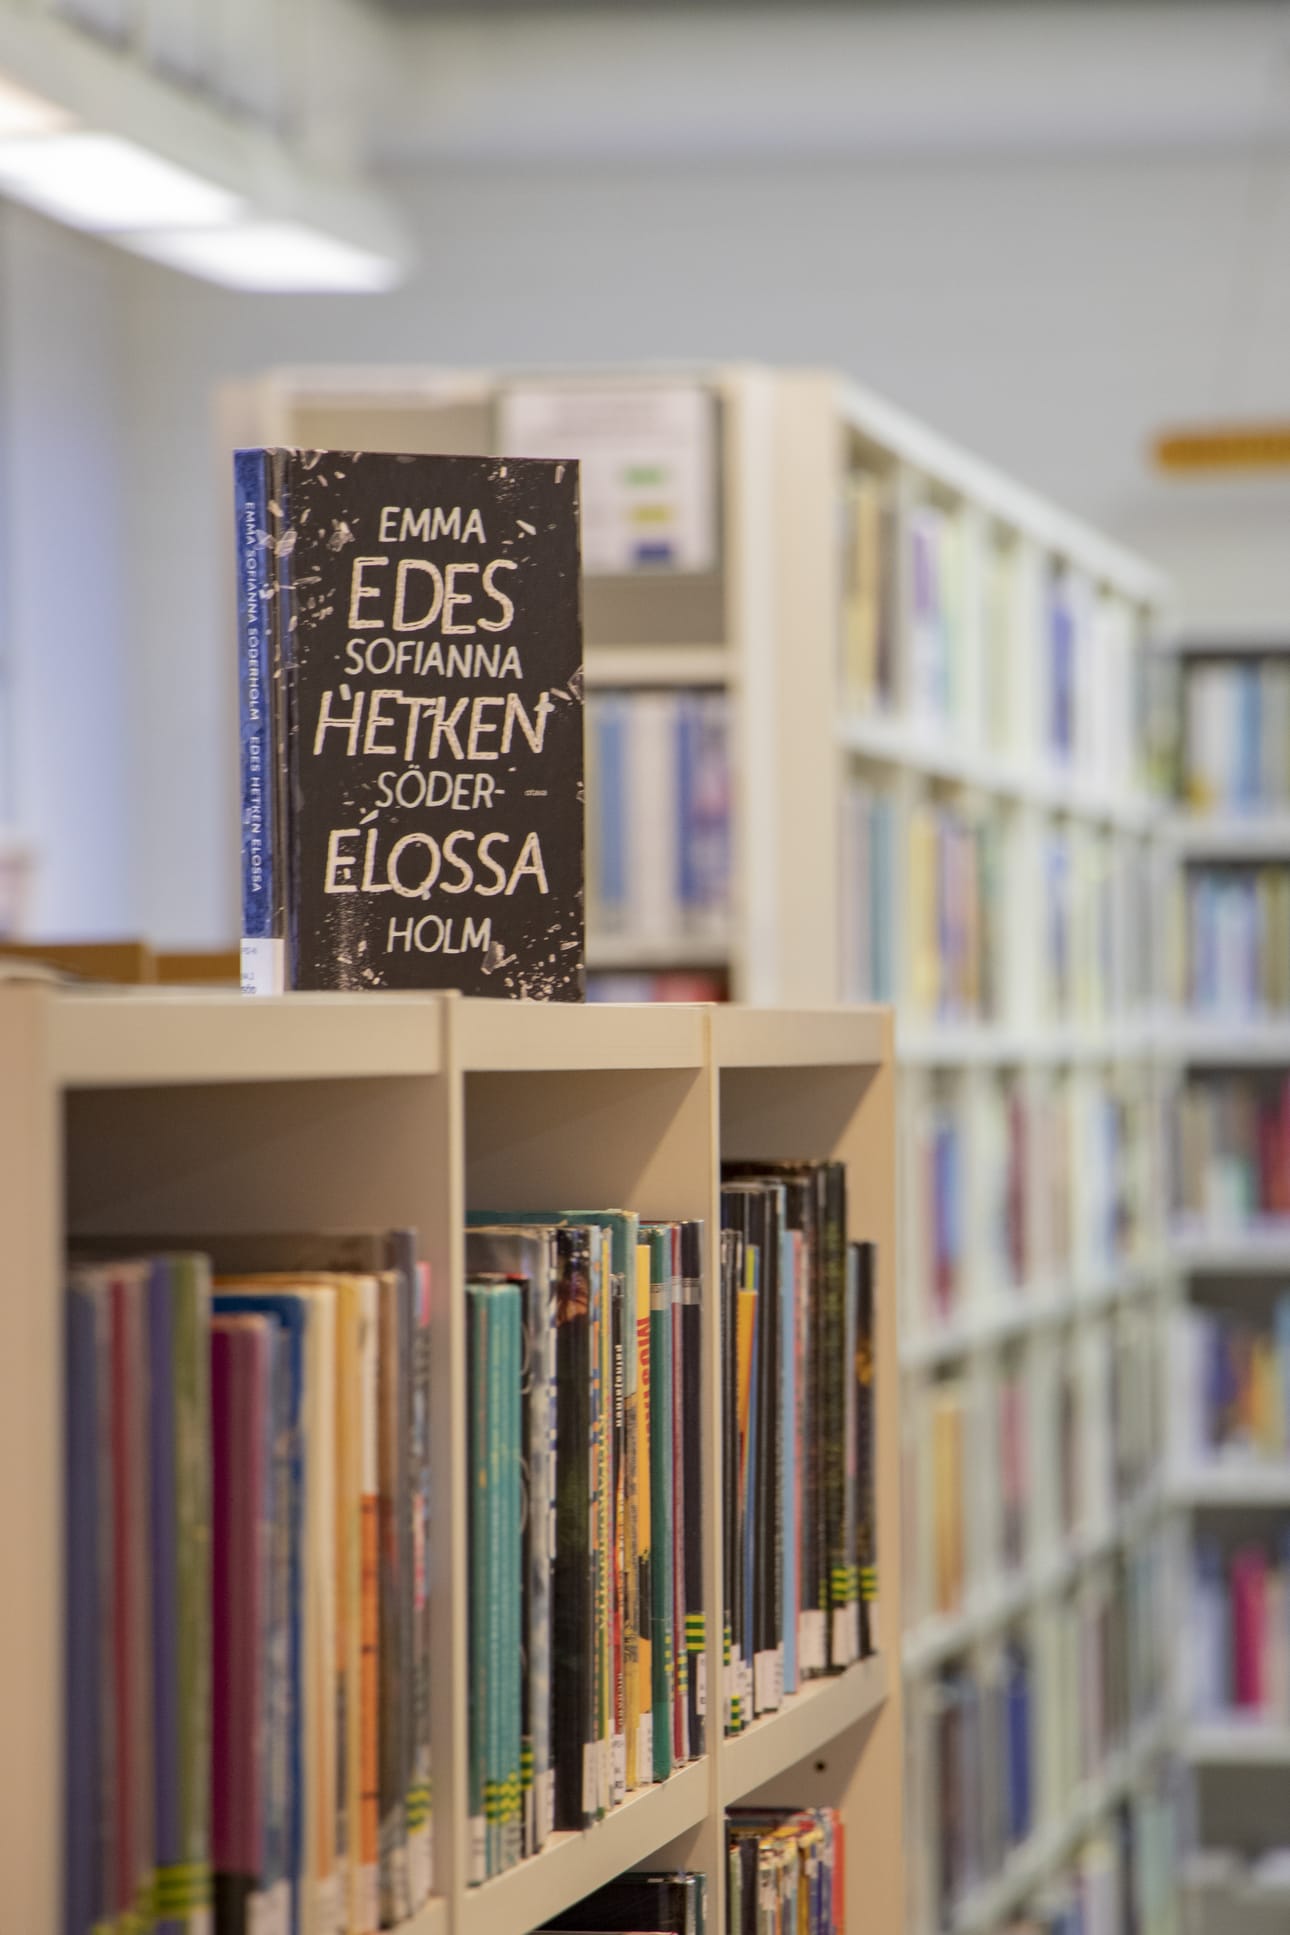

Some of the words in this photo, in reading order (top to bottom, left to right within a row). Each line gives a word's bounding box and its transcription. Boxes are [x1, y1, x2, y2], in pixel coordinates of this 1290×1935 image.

[245, 502, 256, 544] EMMA
[378, 506, 487, 543] EMMA
[246, 550, 258, 623] SOFIANNA
[348, 556, 518, 635] EDES
[344, 637, 524, 680] SOFIANNA
[313, 689, 549, 761] HETKEN
[249, 737, 261, 772] EDES
[250, 777, 262, 833] HETKEN
[375, 765, 506, 810] SÖDER-
[251, 839, 262, 892] ELOSSA
[324, 826, 550, 898] ELOSSA
[387, 914, 492, 954] HOLM
